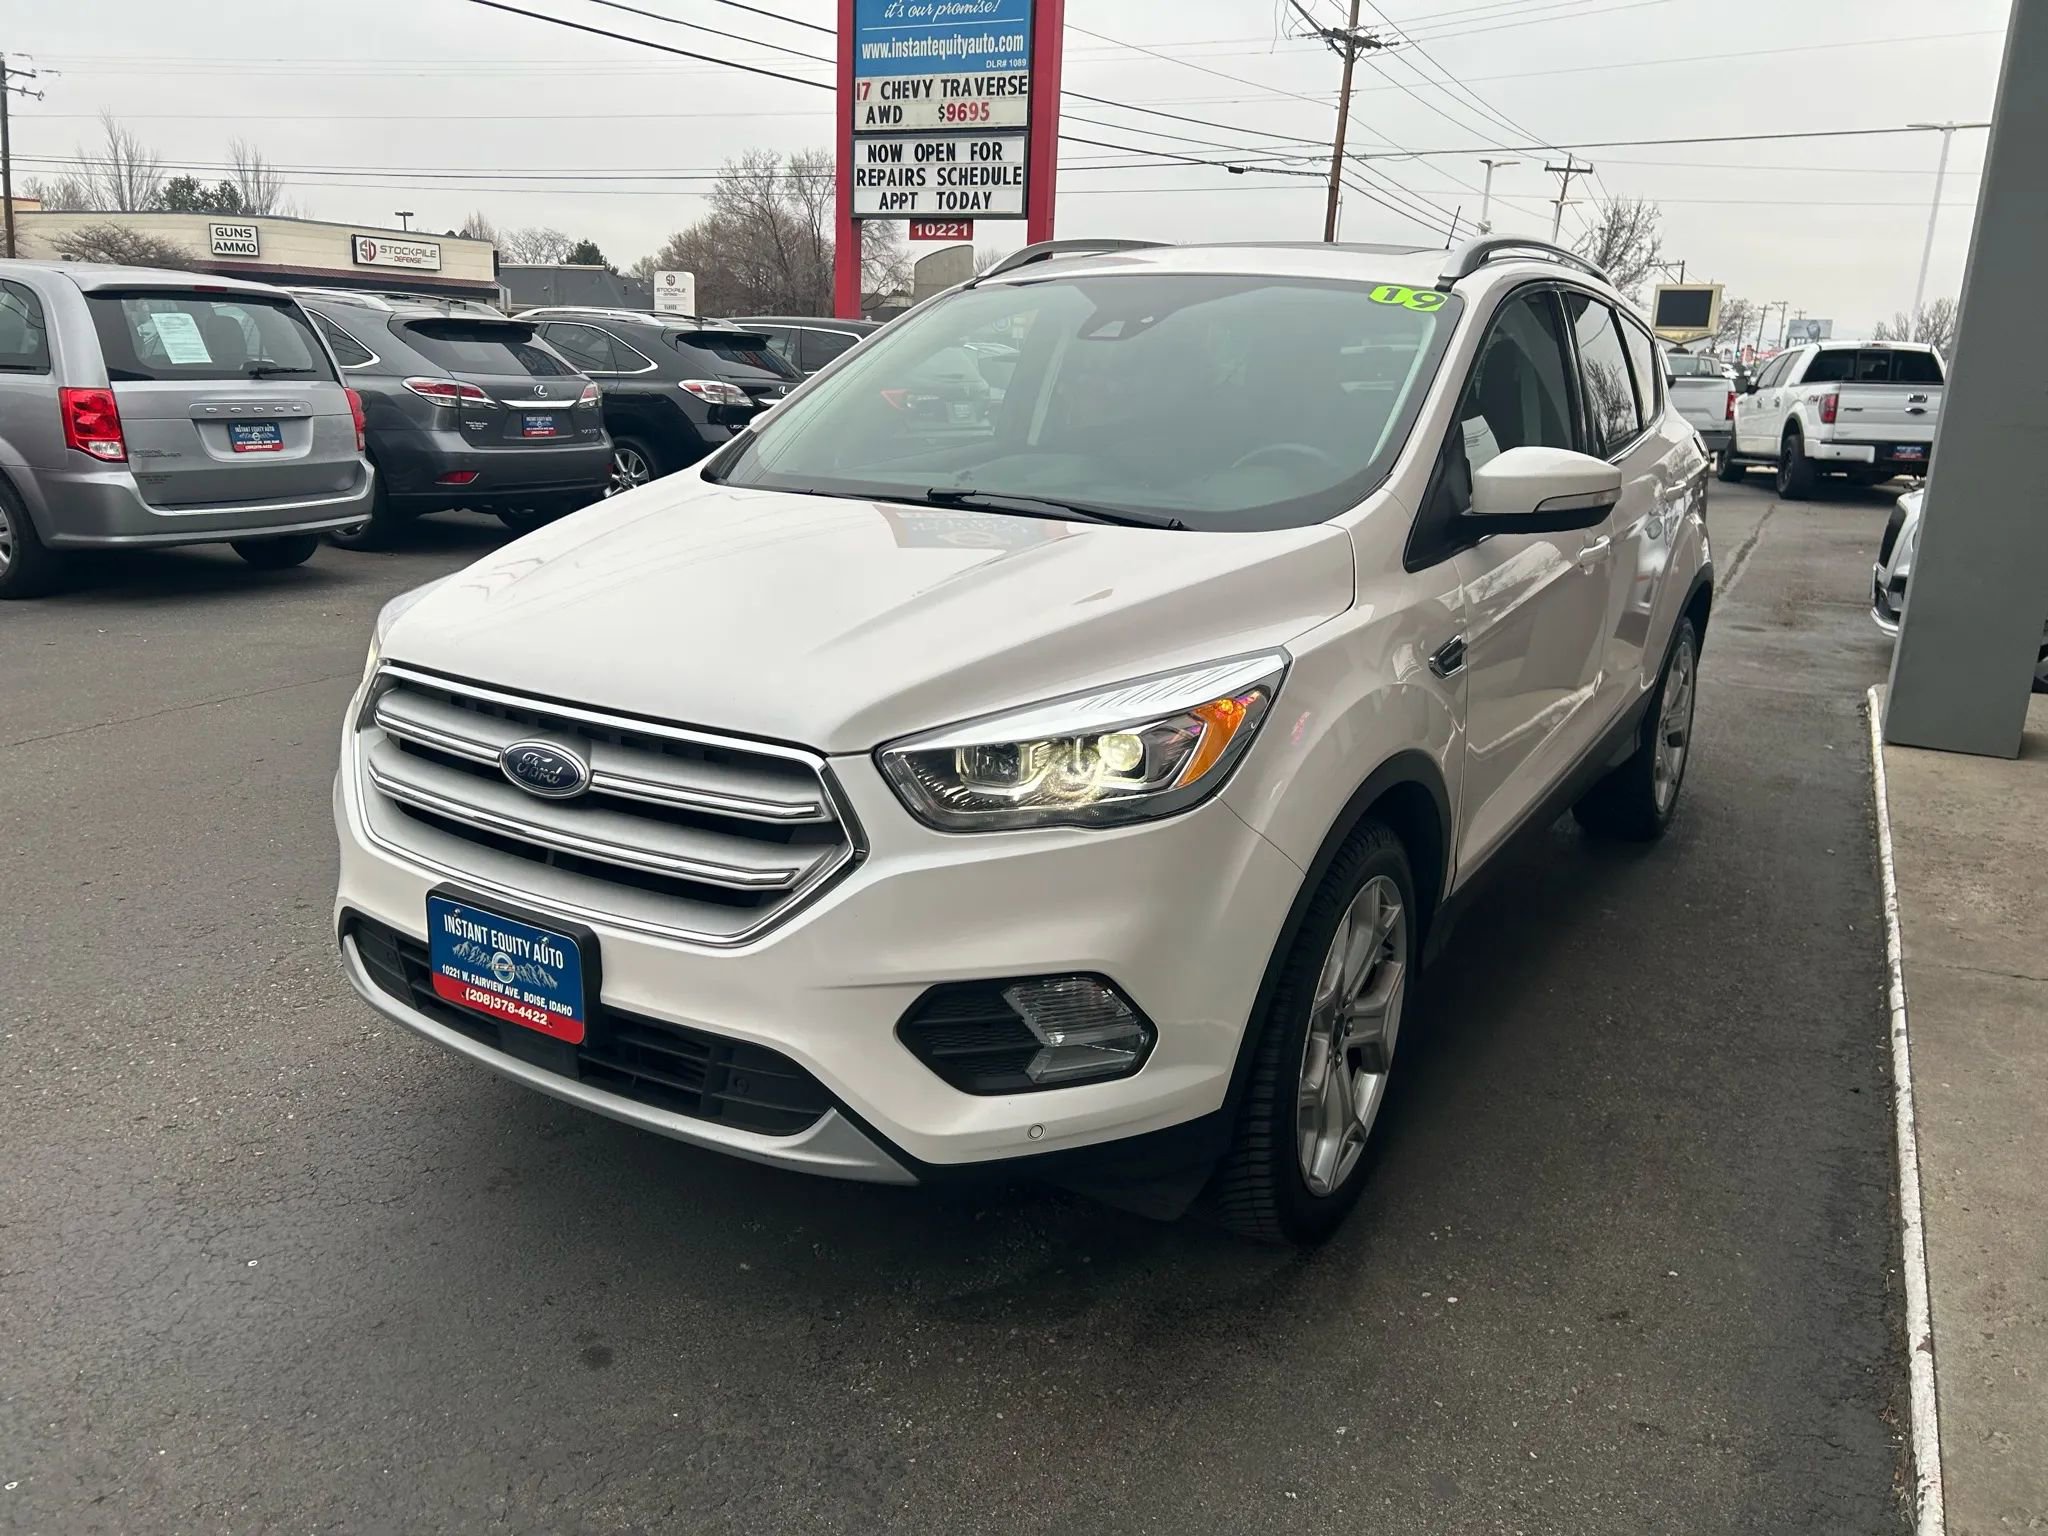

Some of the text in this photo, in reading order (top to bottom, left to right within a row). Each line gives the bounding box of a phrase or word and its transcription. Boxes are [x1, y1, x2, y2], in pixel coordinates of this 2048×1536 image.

[884, 0, 1000, 23] it's our promise!
[862, 33, 1024, 60] www.instantequityauto.com
[986, 58, 1027, 69] DLR# 1089
[856, 75, 1028, 101] 17 CHEVY TRAVERSE
[866, 102, 990, 124] AWD $9695
[867, 142, 1003, 163] NOW OPEN FOR
[856, 166, 1022, 187] REPAIRS SCHEDULE
[879, 192, 992, 210] APPT TODAY
[215, 227, 252, 238] GUNS
[915, 223, 969, 237] 10221
[214, 242, 256, 253] AMMO
[380, 245, 437, 258] STOCKPILE
[394, 256, 422, 264] DEFENSE
[1382, 287, 1446, 308] 19
[517, 752, 563, 784] Ford
[444, 914, 564, 970] INSTANT EQUITY AUTO
[442, 964, 573, 1017] 10221 W. FAIRVIEW AVE. BOISE, IDAHO
[465, 987, 548, 1025] (208)378-4422
